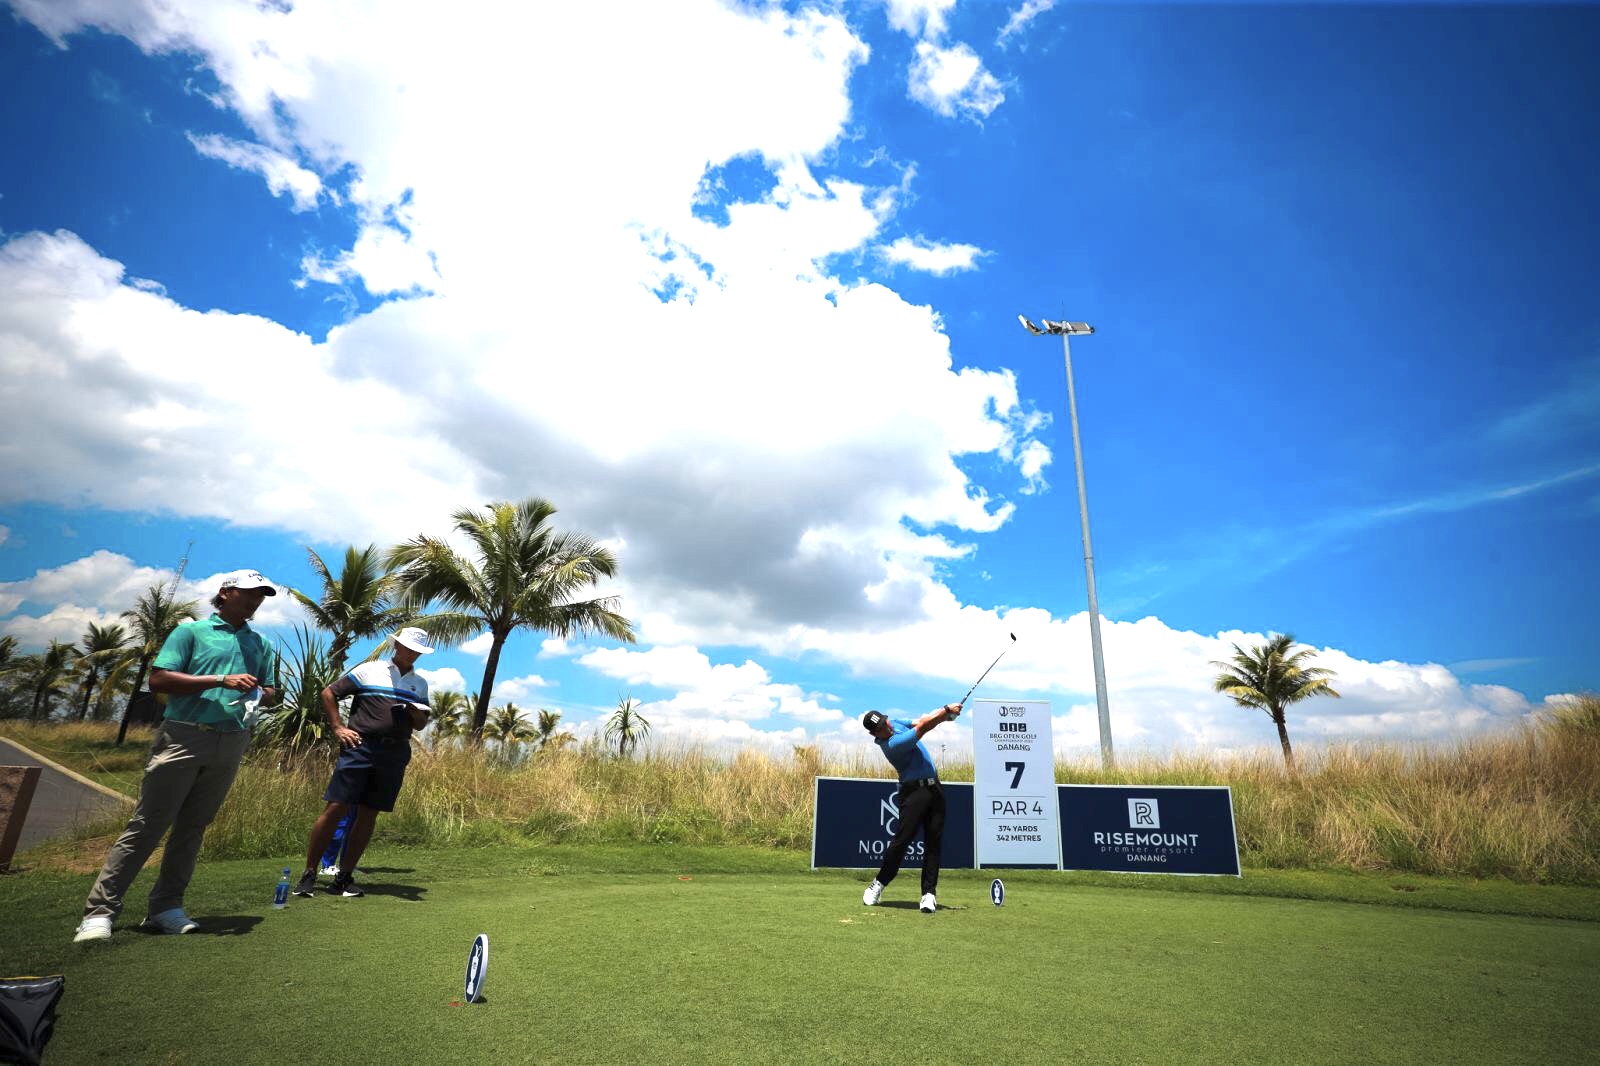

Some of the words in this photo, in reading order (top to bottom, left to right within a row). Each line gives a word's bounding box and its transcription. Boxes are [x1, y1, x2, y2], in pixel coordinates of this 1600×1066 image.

[1005, 761, 1026, 789] 7
[992, 800, 1027, 815] PAR
[1032, 801, 1043, 815] 4
[1094, 832, 1198, 846] RISEMOUNT
[858, 840, 925, 855] NOSS
[1127, 854, 1167, 863] DANANG
